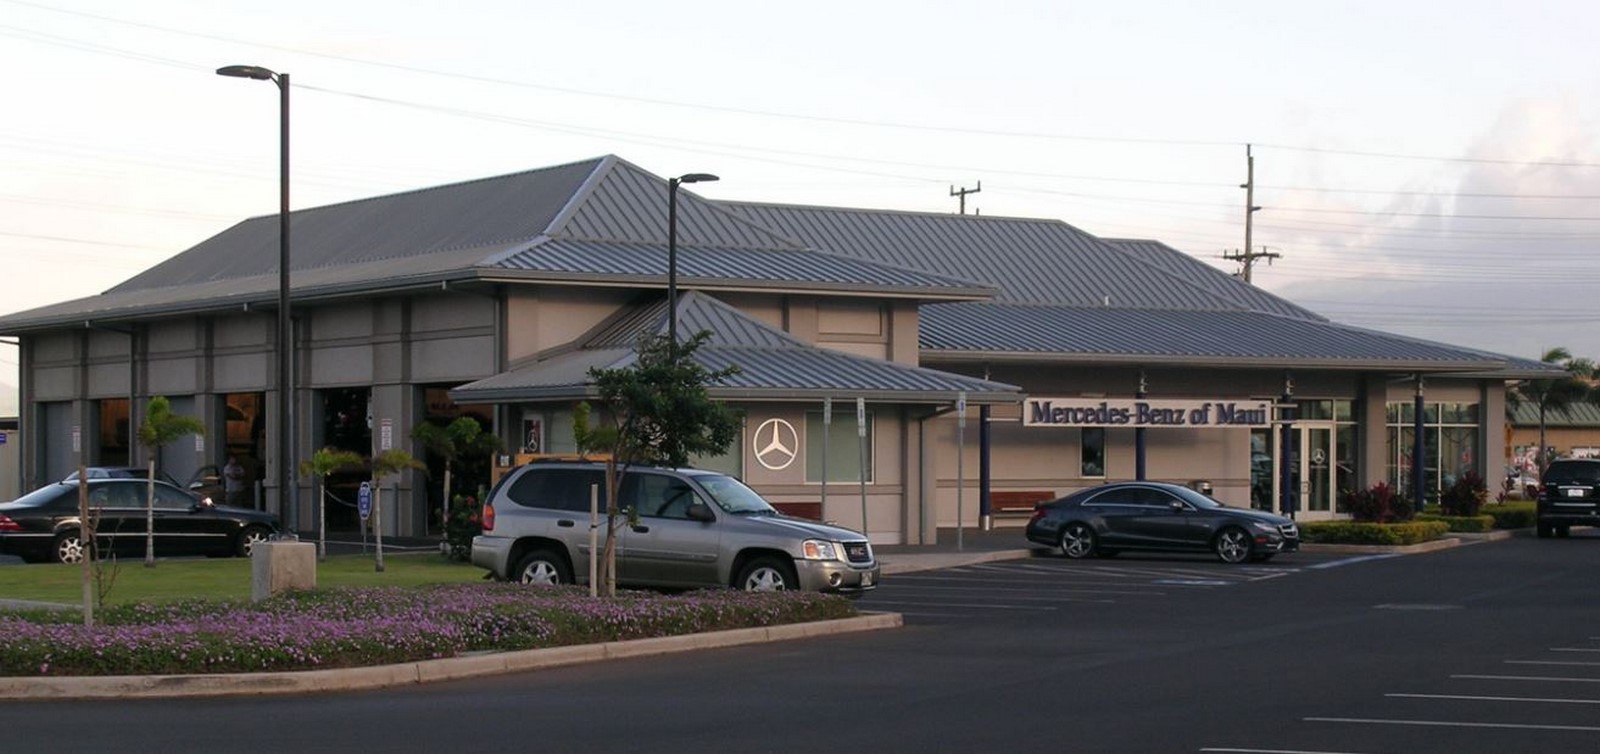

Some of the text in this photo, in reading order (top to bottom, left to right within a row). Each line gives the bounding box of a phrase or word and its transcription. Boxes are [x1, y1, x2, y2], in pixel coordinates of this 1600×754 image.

[1030, 401, 1266, 425] Mercedes-Benz of Maui
